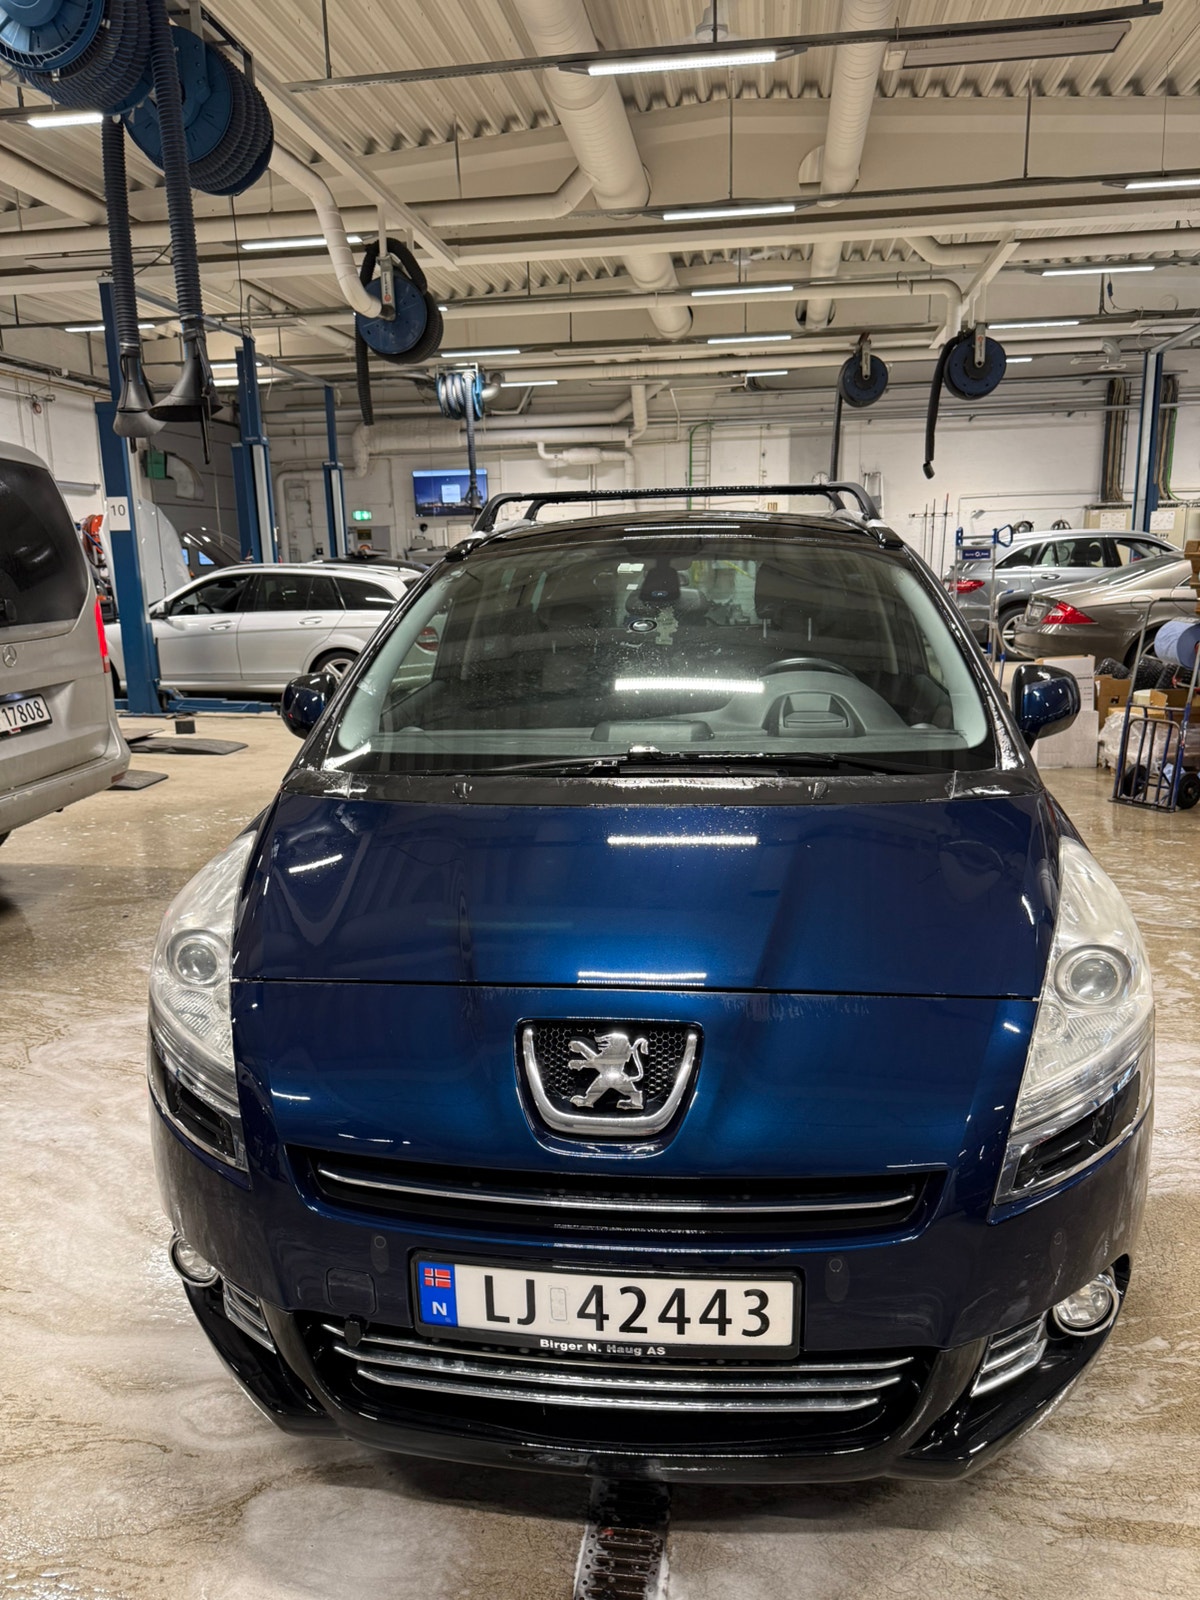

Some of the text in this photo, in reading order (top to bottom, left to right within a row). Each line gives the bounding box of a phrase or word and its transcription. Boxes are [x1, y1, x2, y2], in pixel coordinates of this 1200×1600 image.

[110, 504, 126, 516] 10
[2, 700, 44, 727] 17808
[431, 1300, 448, 1316] N
[484, 1274, 771, 1338] LJ 42443
[539, 1338, 666, 1356] Birger N. Haug AS
